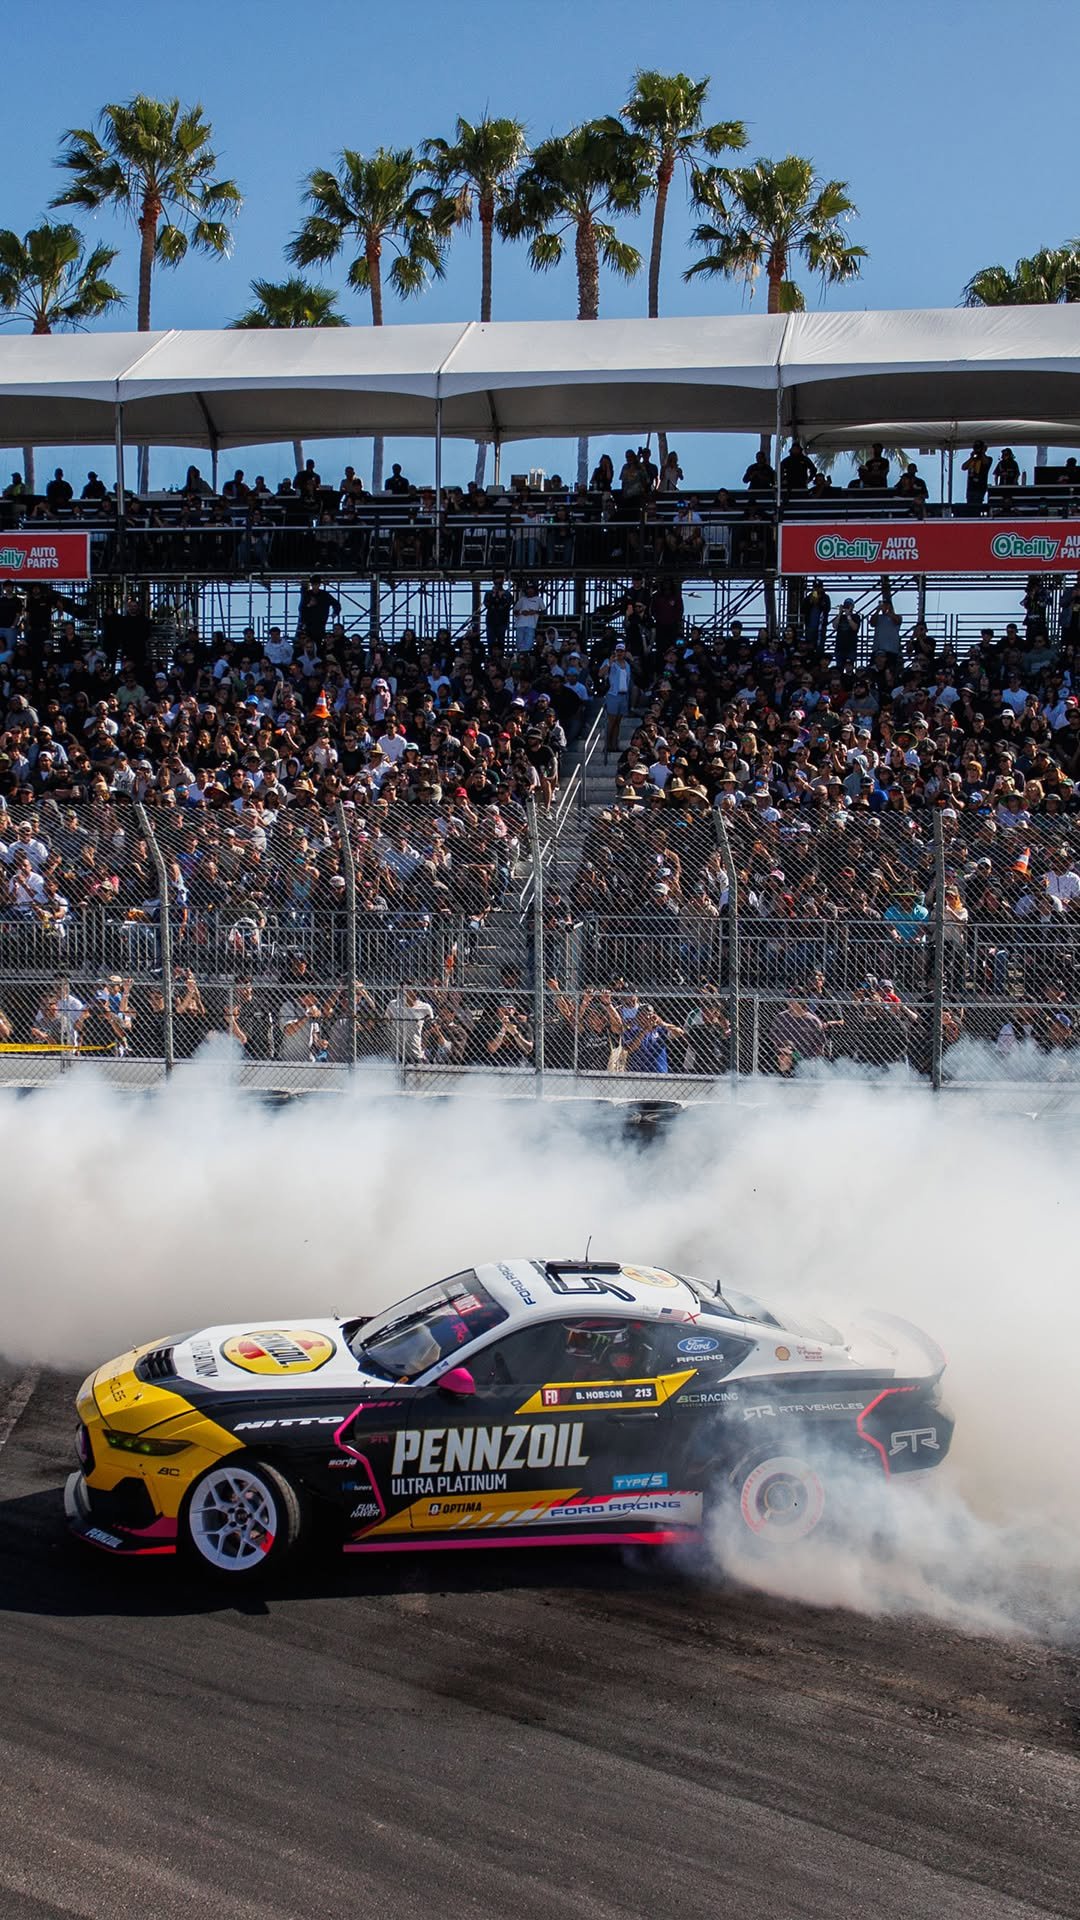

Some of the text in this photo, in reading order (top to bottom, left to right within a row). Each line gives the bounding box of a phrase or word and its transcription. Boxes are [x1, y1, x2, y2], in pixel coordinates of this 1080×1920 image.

[816, 536, 880, 562] O'Reilly
[886, 537, 915, 548] AUTO
[993, 534, 1058, 560] O'Reilly
[30, 547, 56, 557] AUTO
[882, 549, 918, 560] PARTS
[27, 558, 58, 568] PARTS
[685, 1338, 712, 1351] Ford
[676, 1354, 724, 1363] RACING
[545, 1390, 558, 1404] FD
[587, 1390, 623, 1399] HOBSON
[635, 1388, 652, 1398] 213
[779, 1405, 805, 1413] RTR
[804, 1402, 865, 1411] VEHICLES
[233, 1416, 345, 1431] NITTO
[391, 1422, 590, 1475] PENNZOIL
[888, 1427, 940, 1456] RTR
[391, 1473, 507, 1496] ULTRA PLATINUM
[442, 1502, 482, 1514] OPTIMA
[551, 1501, 681, 1517] FORD RACING
